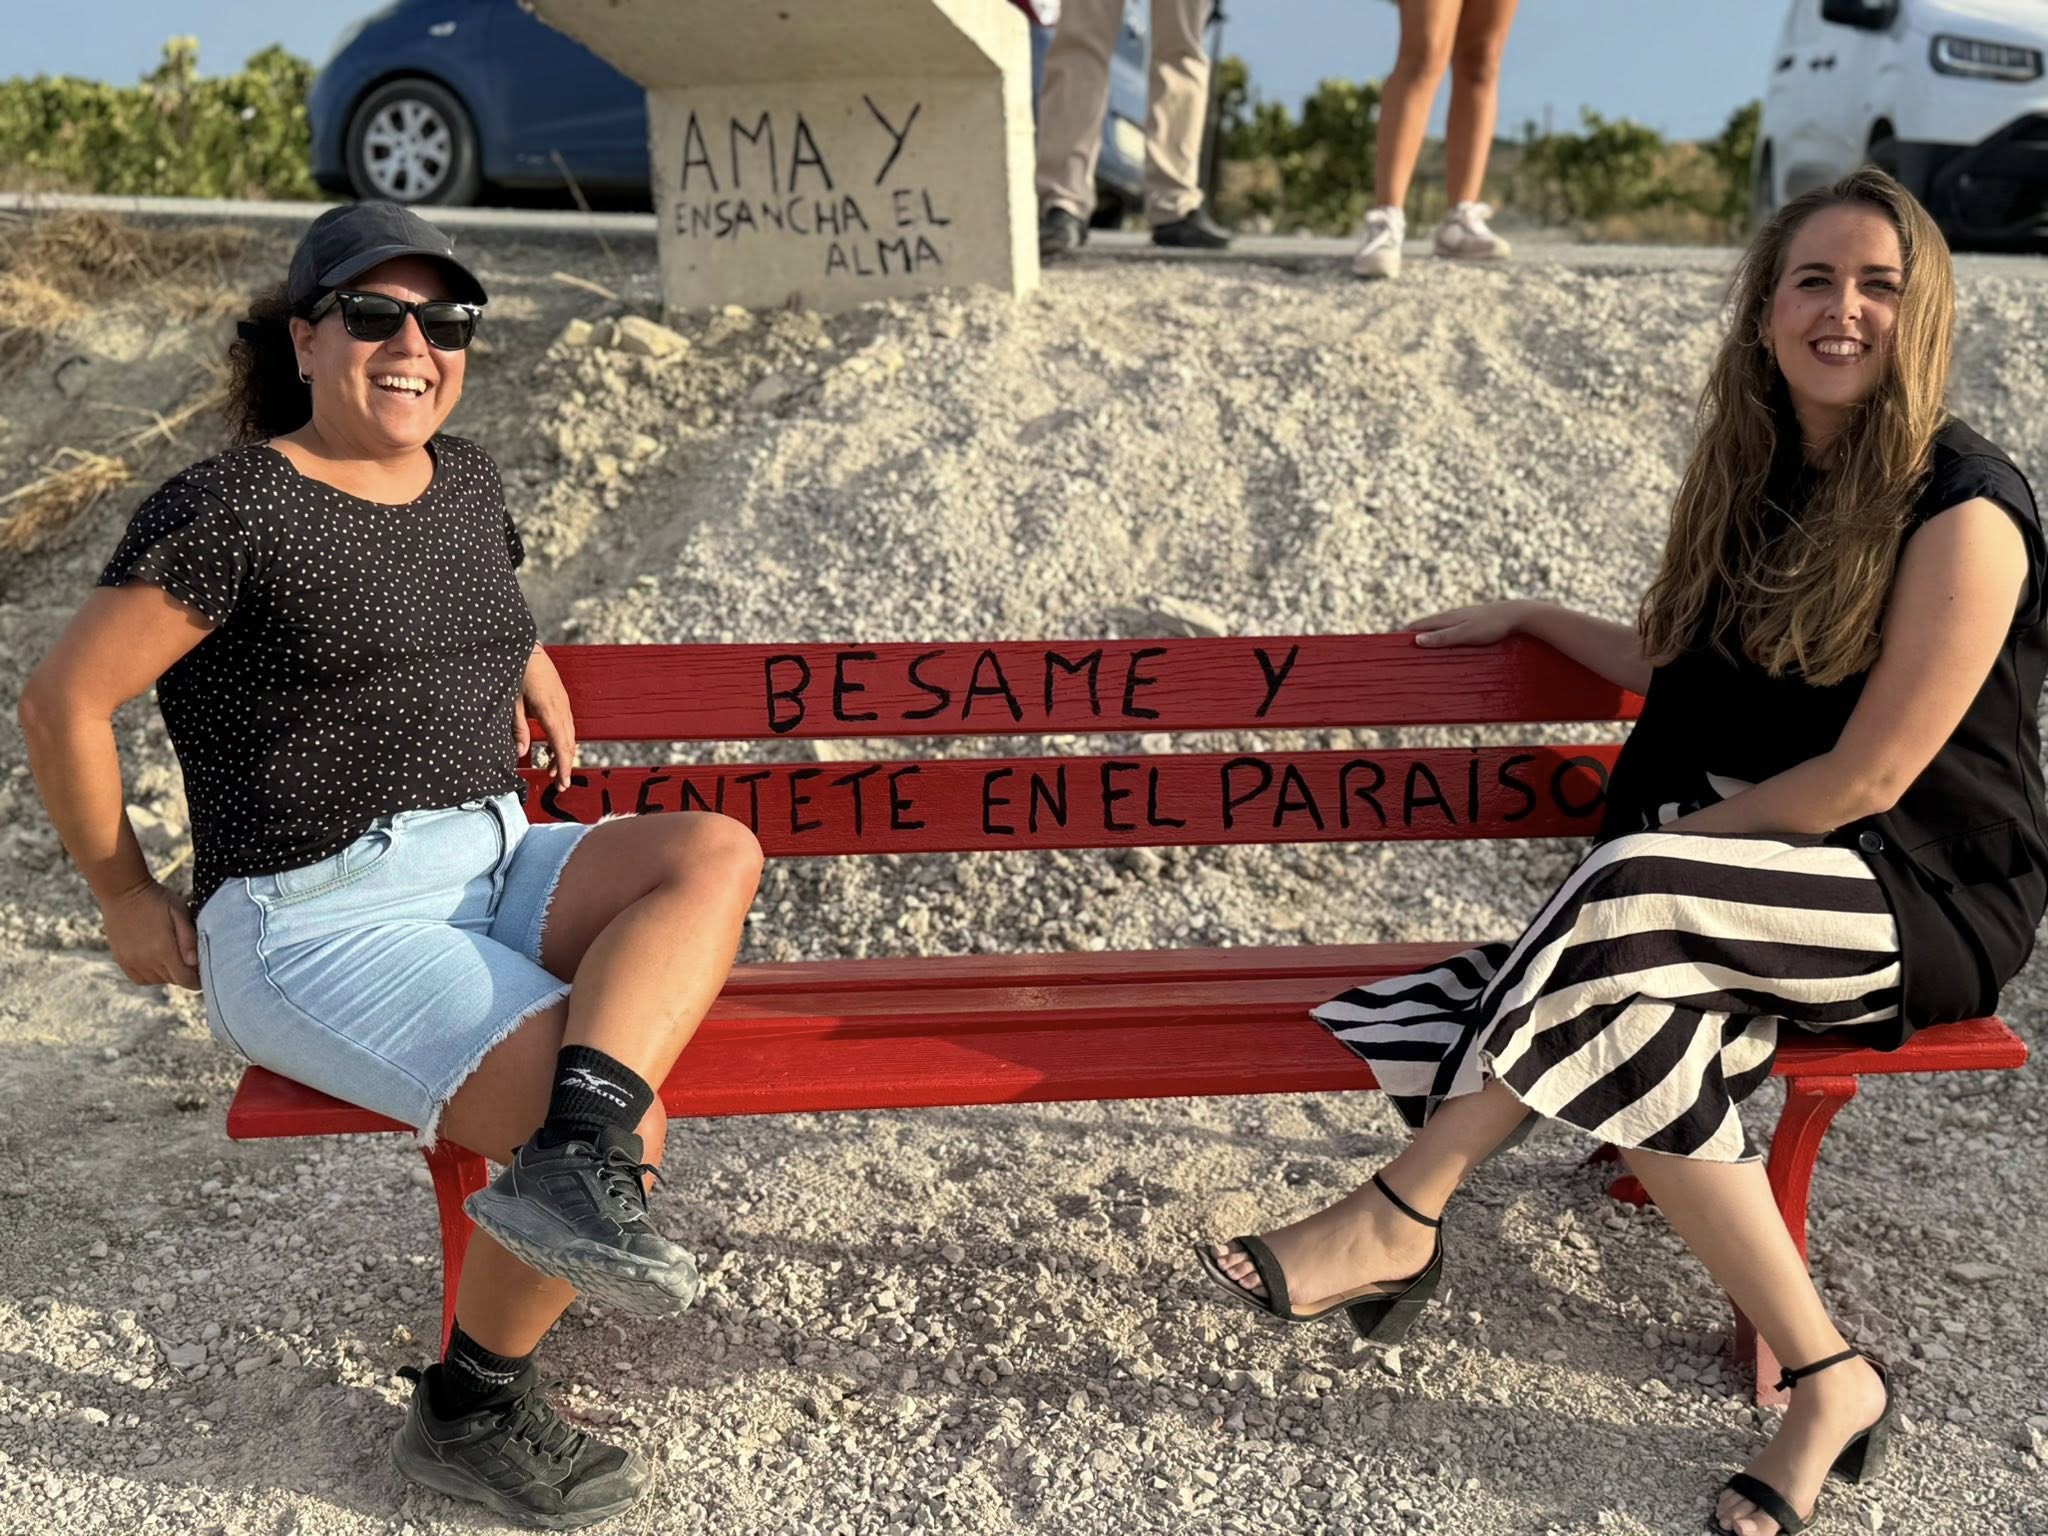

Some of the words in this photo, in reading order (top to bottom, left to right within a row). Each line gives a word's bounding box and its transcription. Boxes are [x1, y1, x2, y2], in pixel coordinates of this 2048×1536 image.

[681, 110, 833, 193] AMA
[862, 93, 922, 187] Y
[674, 194, 870, 240] ENSANCHA
[893, 188, 951, 229] EL
[825, 235, 943, 278] ALMA
[1253, 645, 1299, 717] Y
[982, 764, 1068, 836] EN
[1100, 762, 1186, 832] EL
[1220, 748, 1608, 832] PARAÍSO
